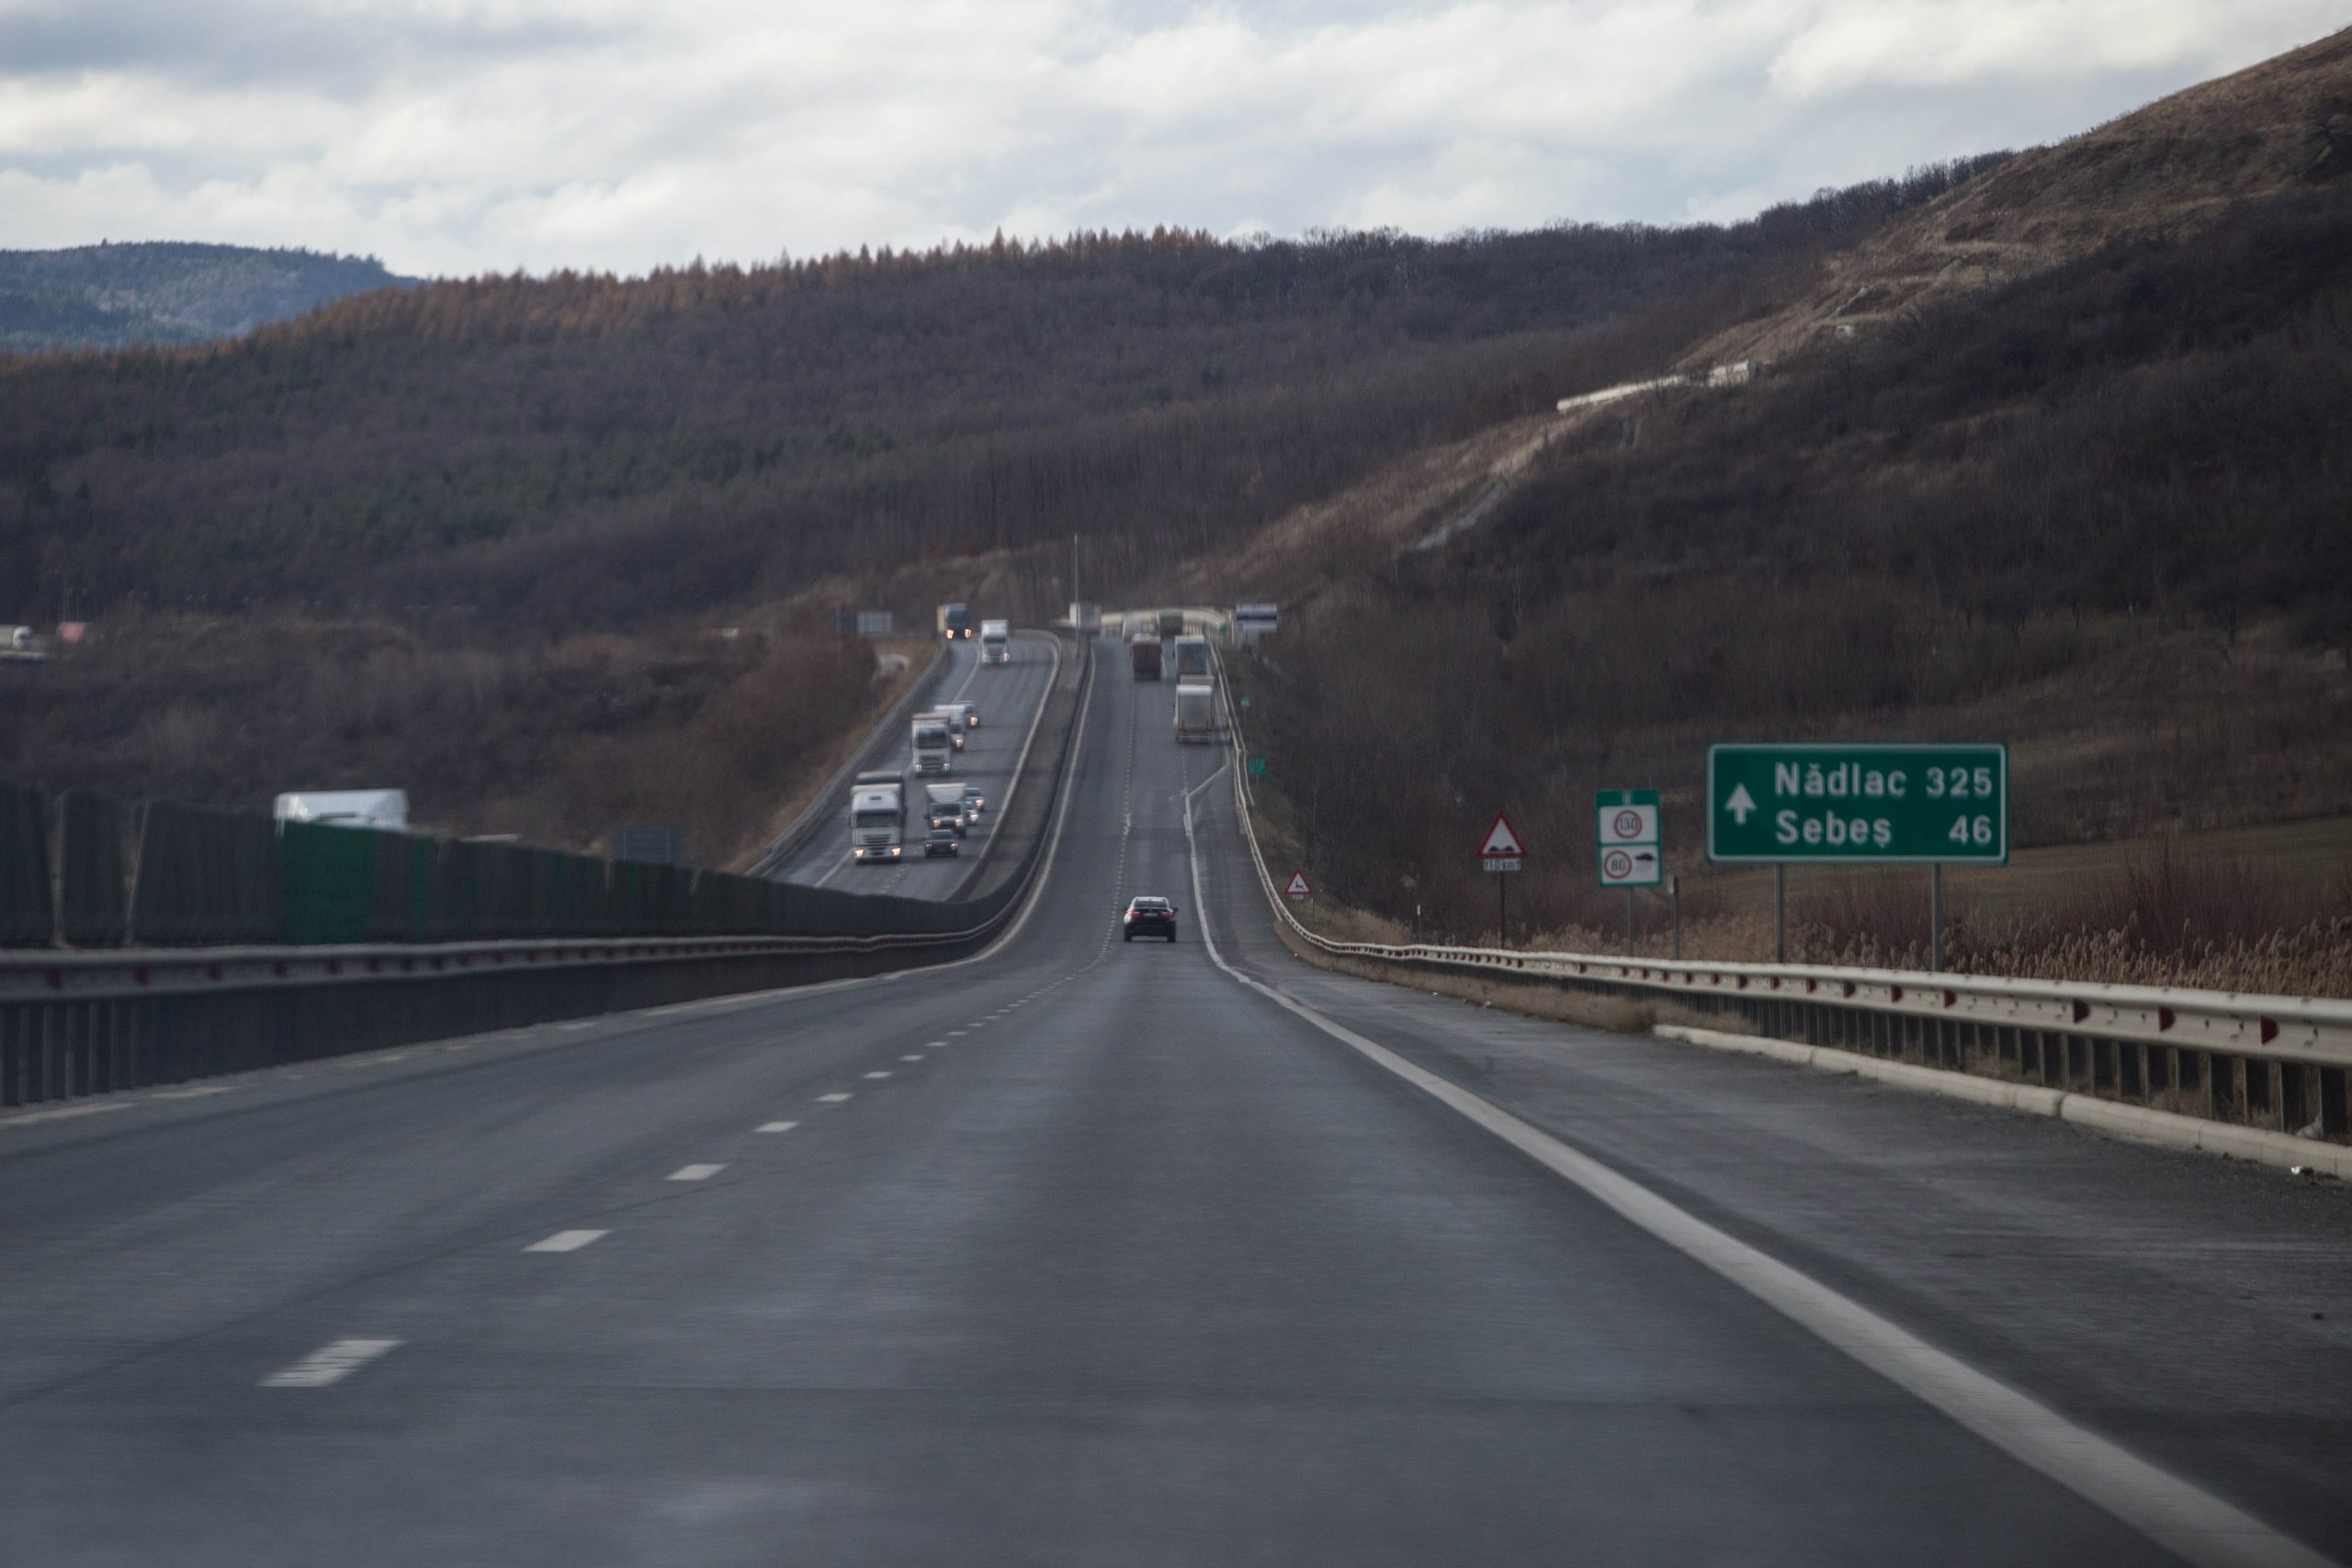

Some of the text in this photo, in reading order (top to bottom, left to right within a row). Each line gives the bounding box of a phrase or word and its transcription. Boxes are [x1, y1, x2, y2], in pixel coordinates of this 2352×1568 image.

[1774, 761, 1994, 798] Nădlac 325
[1620, 818, 1638, 830] 130
[1949, 815, 1994, 846] 46
